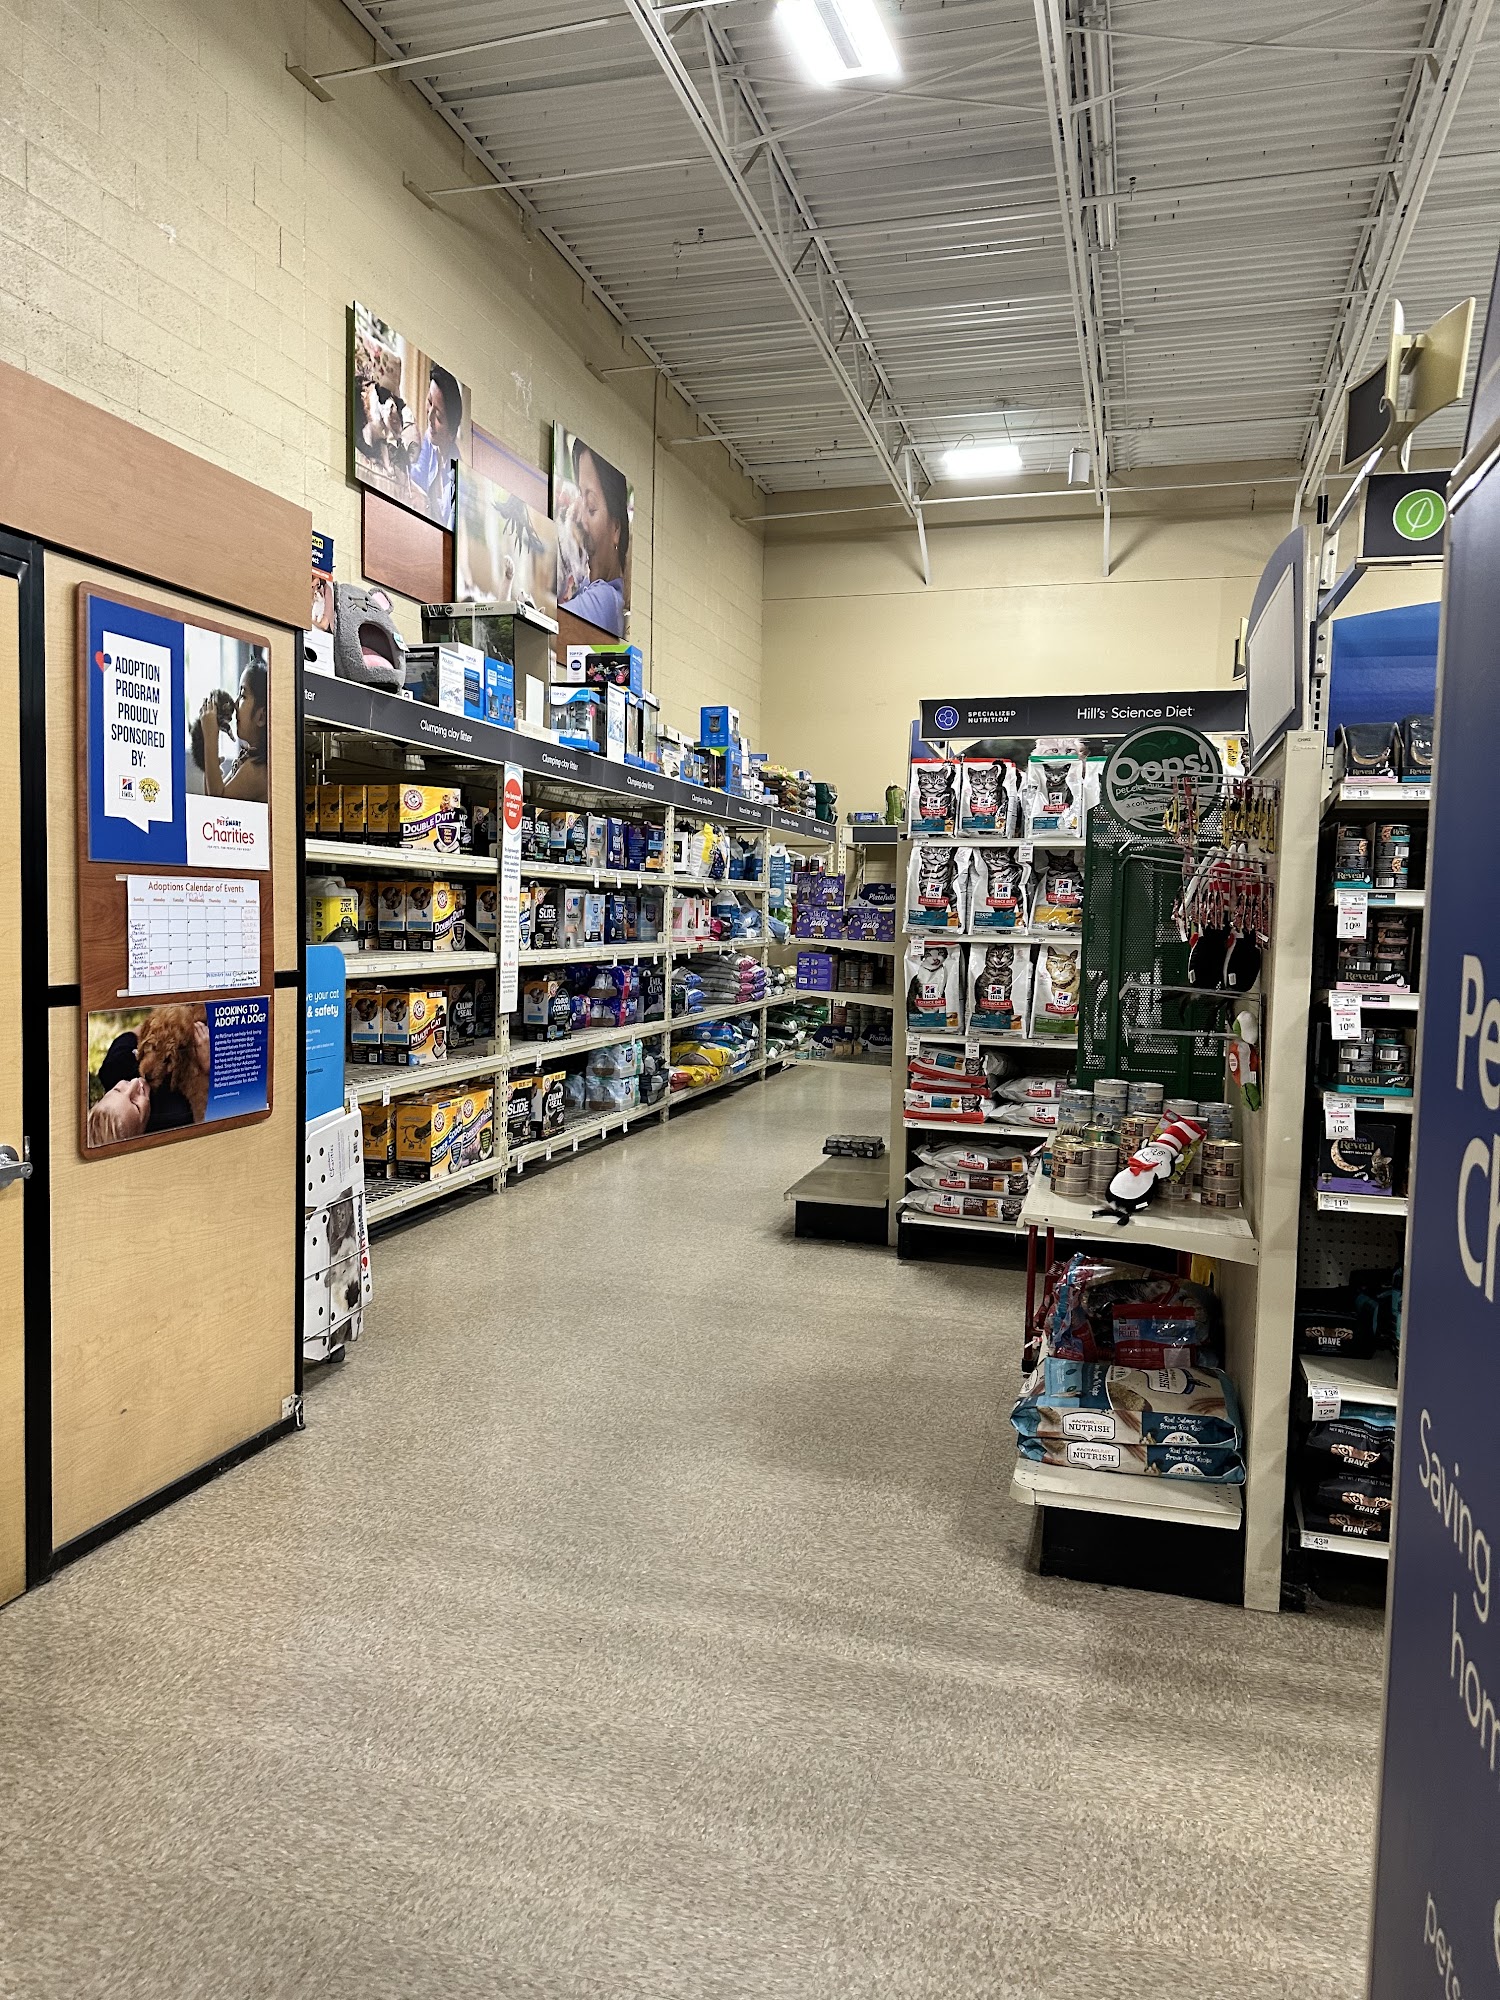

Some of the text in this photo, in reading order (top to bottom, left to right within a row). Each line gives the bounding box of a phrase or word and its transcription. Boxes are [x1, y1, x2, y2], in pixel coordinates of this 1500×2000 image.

[115, 656, 160, 682] ADOPTION
[116, 678, 160, 705] PROGRAM
[118, 702, 159, 726] PROUDLY
[1077, 706, 1194, 720] Hill's Science Diet
[111, 723, 165, 749] SPONSORED
[420, 719, 473, 744] Clumping clay litter
[131, 749, 146, 768] BY:
[541, 753, 562, 768] Clumping
[561, 760, 569, 770] clay
[403, 817, 434, 834] DOUBLE
[202, 821, 255, 845] Charities
[148, 881, 244, 893] Adoptions Calendar of Events
[538, 908, 556, 919] SLIDE
[1345, 972, 1378, 981] Reveal
[315, 992, 328, 1003] your
[330, 989, 339, 999] cat
[648, 985, 662, 995] CLEAN
[215, 1004, 259, 1017] LOOKING TO
[307, 1004, 339, 1018] & safety
[215, 1013, 266, 1027] ADOPT A DOG?
[1346, 1075, 1379, 1084] Reveal
[508, 1102, 529, 1115] SLIDE
[1340, 1141, 1375, 1150] Reveal
[1318, 1337, 1341, 1346] CRAVE
[1068, 1424, 1111, 1433] NUTRISH
[1072, 1452, 1116, 1462] NUTRISH
[1343, 1456, 1369, 1469] CRAVE
[1354, 1505, 1380, 1515] CRAVE
[1419, 1408, 1491, 1624] Saving
[1342, 1525, 1368, 1535] CRAVE
